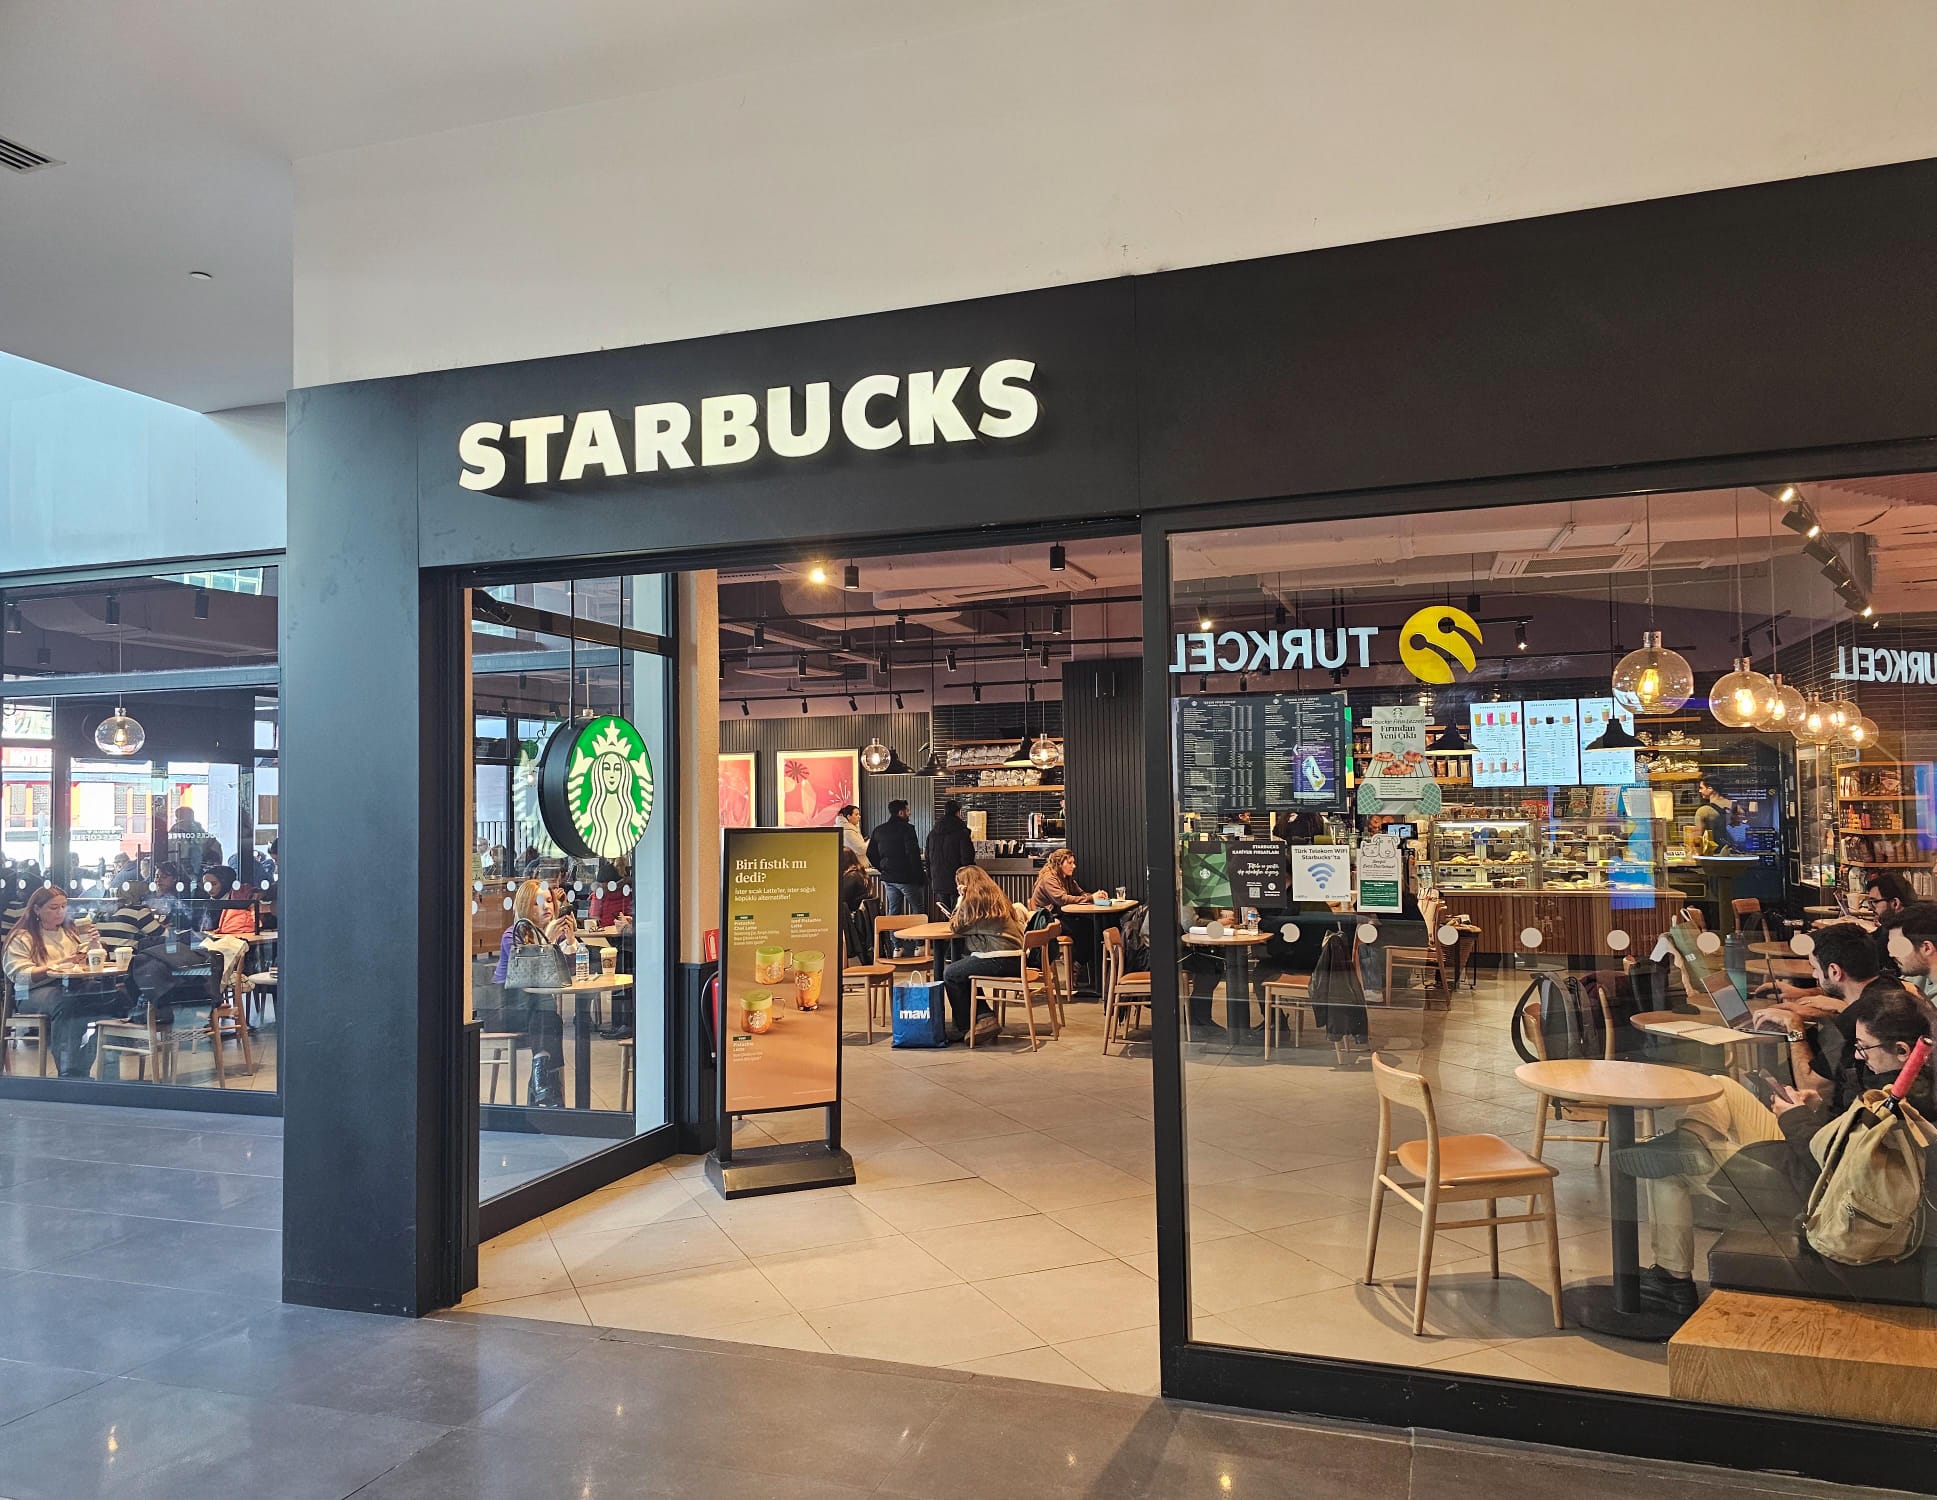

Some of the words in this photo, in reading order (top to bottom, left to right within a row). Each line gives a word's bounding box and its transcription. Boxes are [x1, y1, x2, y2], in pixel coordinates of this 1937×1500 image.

[458, 358, 1038, 491] STARBUCKS
[1380, 732, 1397, 740] Yeni
[736, 859, 758, 871] Biri
[792, 860, 807, 869] mı
[735, 872, 767, 884] dedi?
[900, 1008, 930, 1020] mavi
